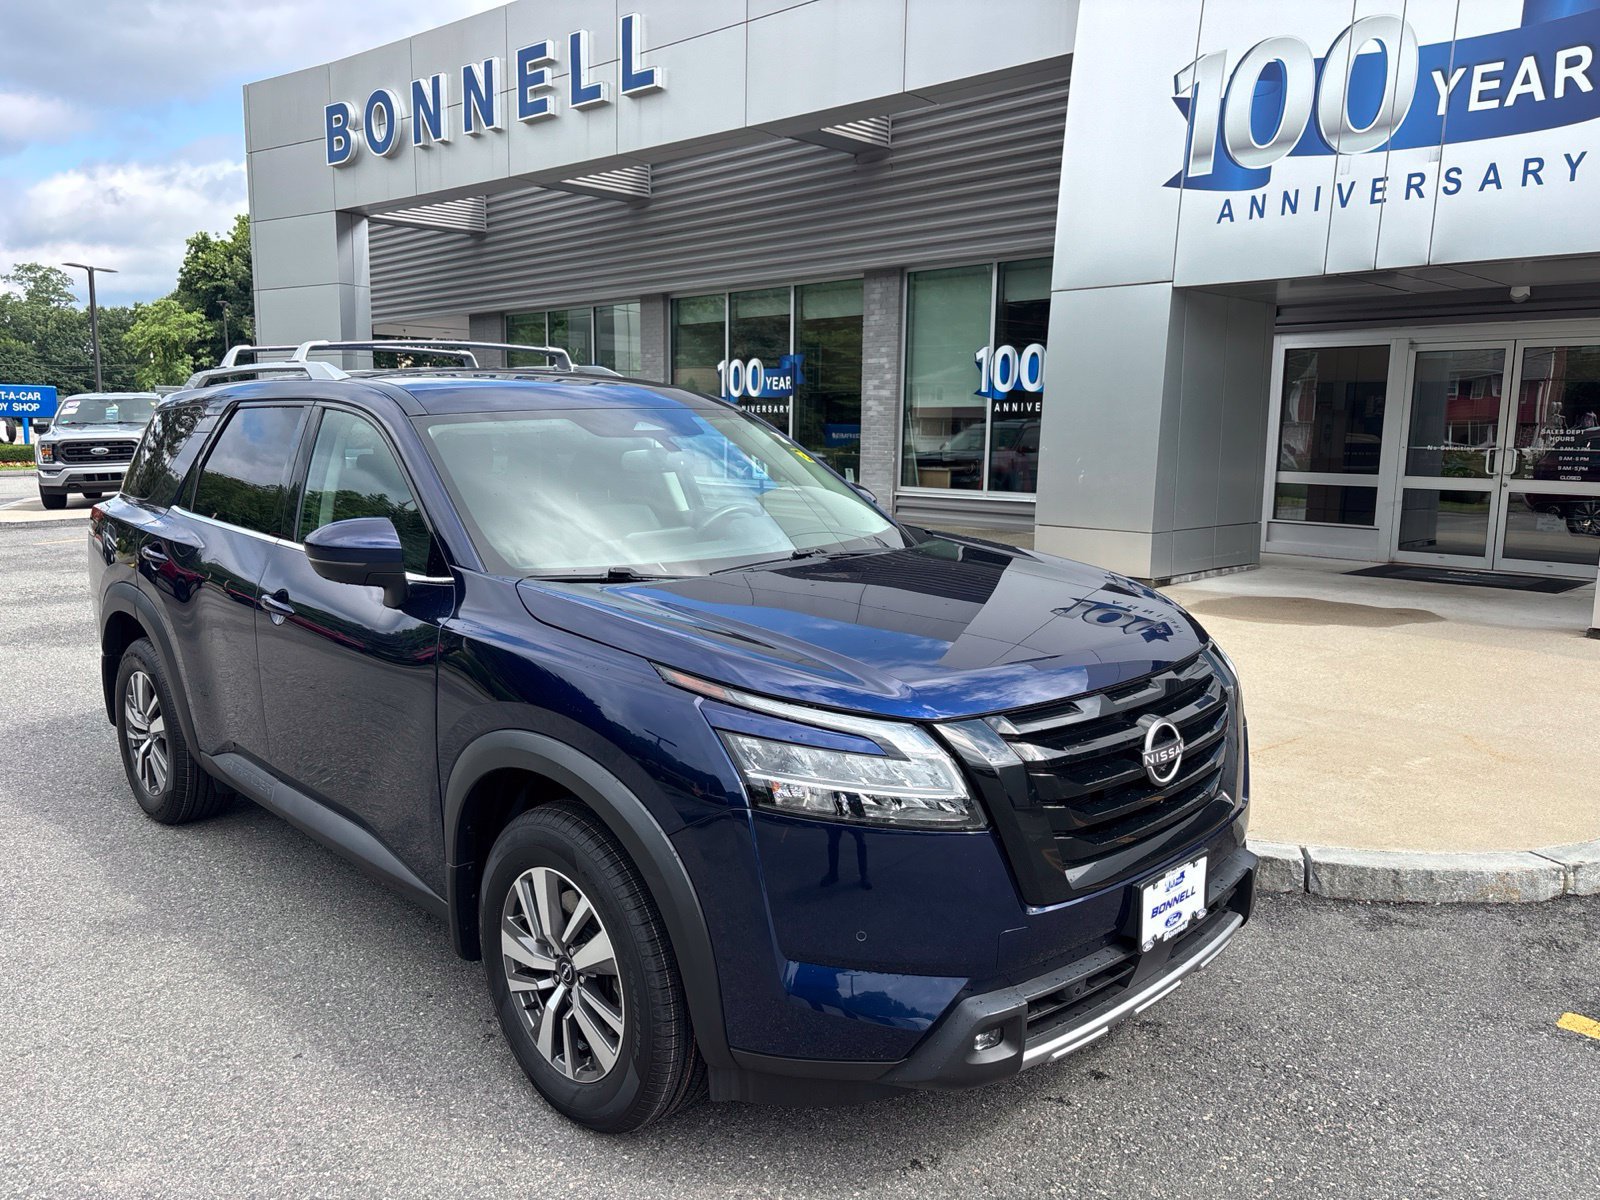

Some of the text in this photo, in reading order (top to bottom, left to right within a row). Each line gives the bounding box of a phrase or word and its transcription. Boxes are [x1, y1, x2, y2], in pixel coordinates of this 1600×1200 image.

[324, 12, 664, 168] BONNELL
[1173, 13, 1595, 178] 100 YEAR
[1216, 150, 1589, 225] ANNIVERSARY
[717, 357, 792, 398] 100 YEAR
[975, 343, 1047, 393] 100
[12, 402, 41, 412] SHOP
[993, 402, 1041, 412] ANNIVE
[1150, 885, 1197, 919] BONNELL
